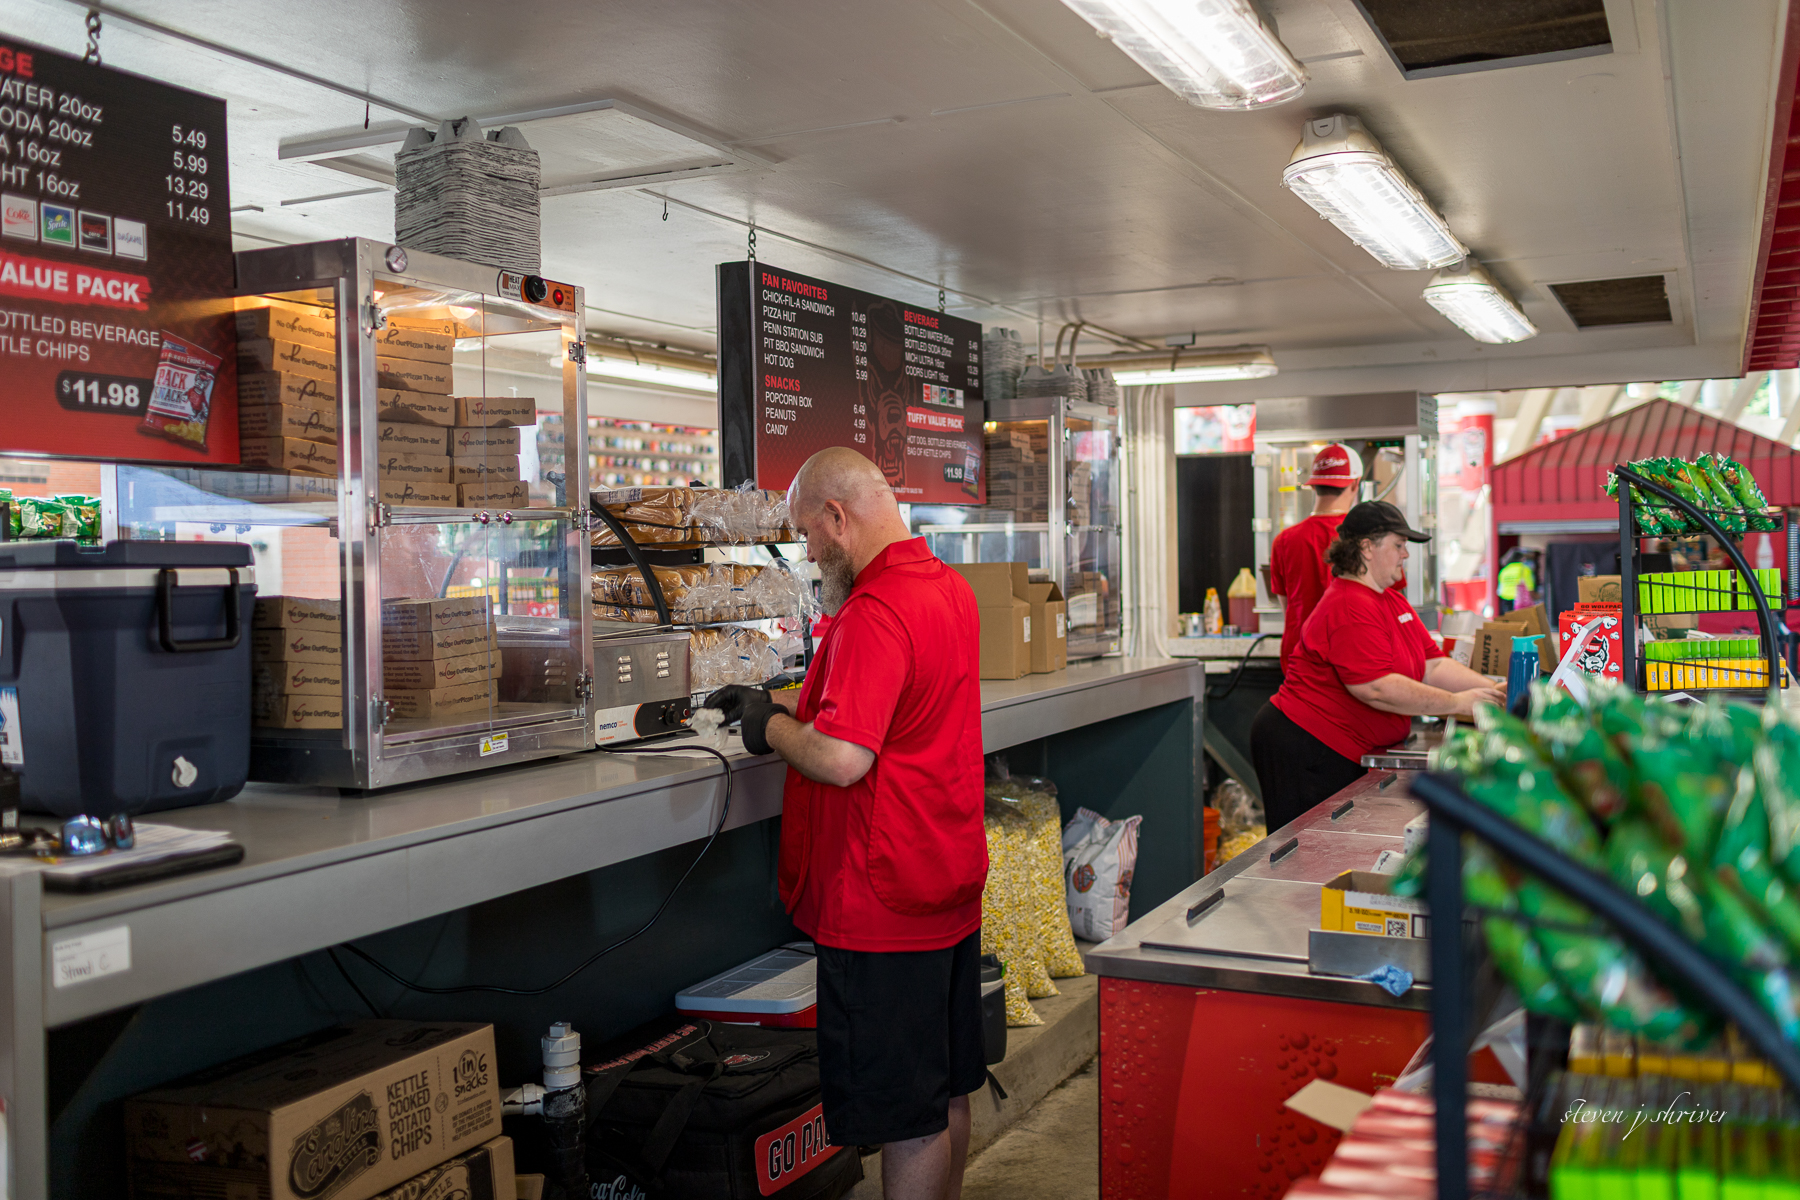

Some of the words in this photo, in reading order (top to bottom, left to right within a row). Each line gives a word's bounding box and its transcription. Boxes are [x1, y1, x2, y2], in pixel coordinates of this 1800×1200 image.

[0, 75, 53, 109] ATER
[59, 95, 103, 122] 20oz
[49, 119, 93, 147] 20oz
[172, 125, 207, 149] 5.49
[17, 139, 61, 166] 16oz
[173, 151, 208, 174] 5.99
[1, 162, 30, 187] HT
[37, 172, 79, 198] 16oz
[166, 174, 209, 199] 13.29
[6, 207, 30, 221] Coke
[167, 200, 210, 225] 11.49
[47, 219, 68, 232] Sprite
[0, 260, 69, 292] ALUE
[76, 273, 141, 304] PACK
[762, 272, 779, 289] FAN
[781, 278, 828, 301] FAVORITES
[762, 289, 801, 309] CHICK-FIL-A
[801, 299, 835, 317] SANDWICH
[763, 305, 782, 320] PIZZA
[783, 310, 797, 324] HUT
[851, 311, 867, 324] 10.49
[904, 310, 939, 330] BEVERAGE
[70, 320, 160, 348] BEVERAGE
[763, 320, 782, 336] PENN
[782, 325, 809, 342] STATION
[810, 331, 824, 344] SUB
[851, 325, 867, 338] 10.29
[904, 324, 927, 339] BOTTLED
[927, 329, 943, 342] WATER
[36, 340, 90, 362] CHIPS
[763, 336, 775, 350] PIT
[775, 339, 790, 353] BBQ
[790, 342, 825, 359] SANDWICH
[852, 340, 868, 352] 10.50
[904, 338, 927, 352] BOTTLED
[927, 343, 941, 355] SODA
[764, 353, 778, 366] HOT
[779, 355, 795, 369] DOG
[855, 355, 868, 367] 9.49
[905, 351, 919, 363] MICH
[919, 355, 935, 367] ULTRA
[156, 368, 188, 391] PACK
[765, 374, 801, 392] SNACKS
[855, 369, 868, 381] 5.99
[905, 365, 924, 378] COORS
[924, 368, 939, 380] LIGHT
[62, 379, 141, 408] $11.98
[765, 391, 798, 406] POPCORN
[799, 395, 813, 408] BOX
[765, 406, 797, 422] PEANUTS
[853, 403, 866, 415] 6.49
[765, 422, 789, 436] CANDY
[853, 418, 866, 430] 4.99
[907, 411, 927, 425] TUFFY
[927, 414, 947, 427] VALUE
[947, 417, 963, 430] PACK
[853, 432, 866, 444] 4.29
[907, 435, 917, 445] HOT
[927, 437, 946, 448] BOTTLED
[907, 446, 917, 456] BAG
[917, 448, 923, 456] OF
[923, 448, 939, 458] KETTLE
[939, 449, 952, 459] CHIPS
[1481, 634, 1492, 675] EANUTS
[599, 721, 618, 731] nemco
[61, 960, 92, 980] Stand
[453, 1066, 459, 1084] 1
[462, 1058, 474, 1075] in
[478, 1053, 488, 1073] 6
[386, 1070, 429, 1102] KETTLE
[455, 1073, 488, 1098] snacks
[388, 1088, 431, 1120] COOKED
[390, 1106, 431, 1139] POTATO
[288, 1107, 379, 1199] Carolina
[391, 1125, 433, 1161] CHIPS
[768, 1131, 797, 1182] GO
